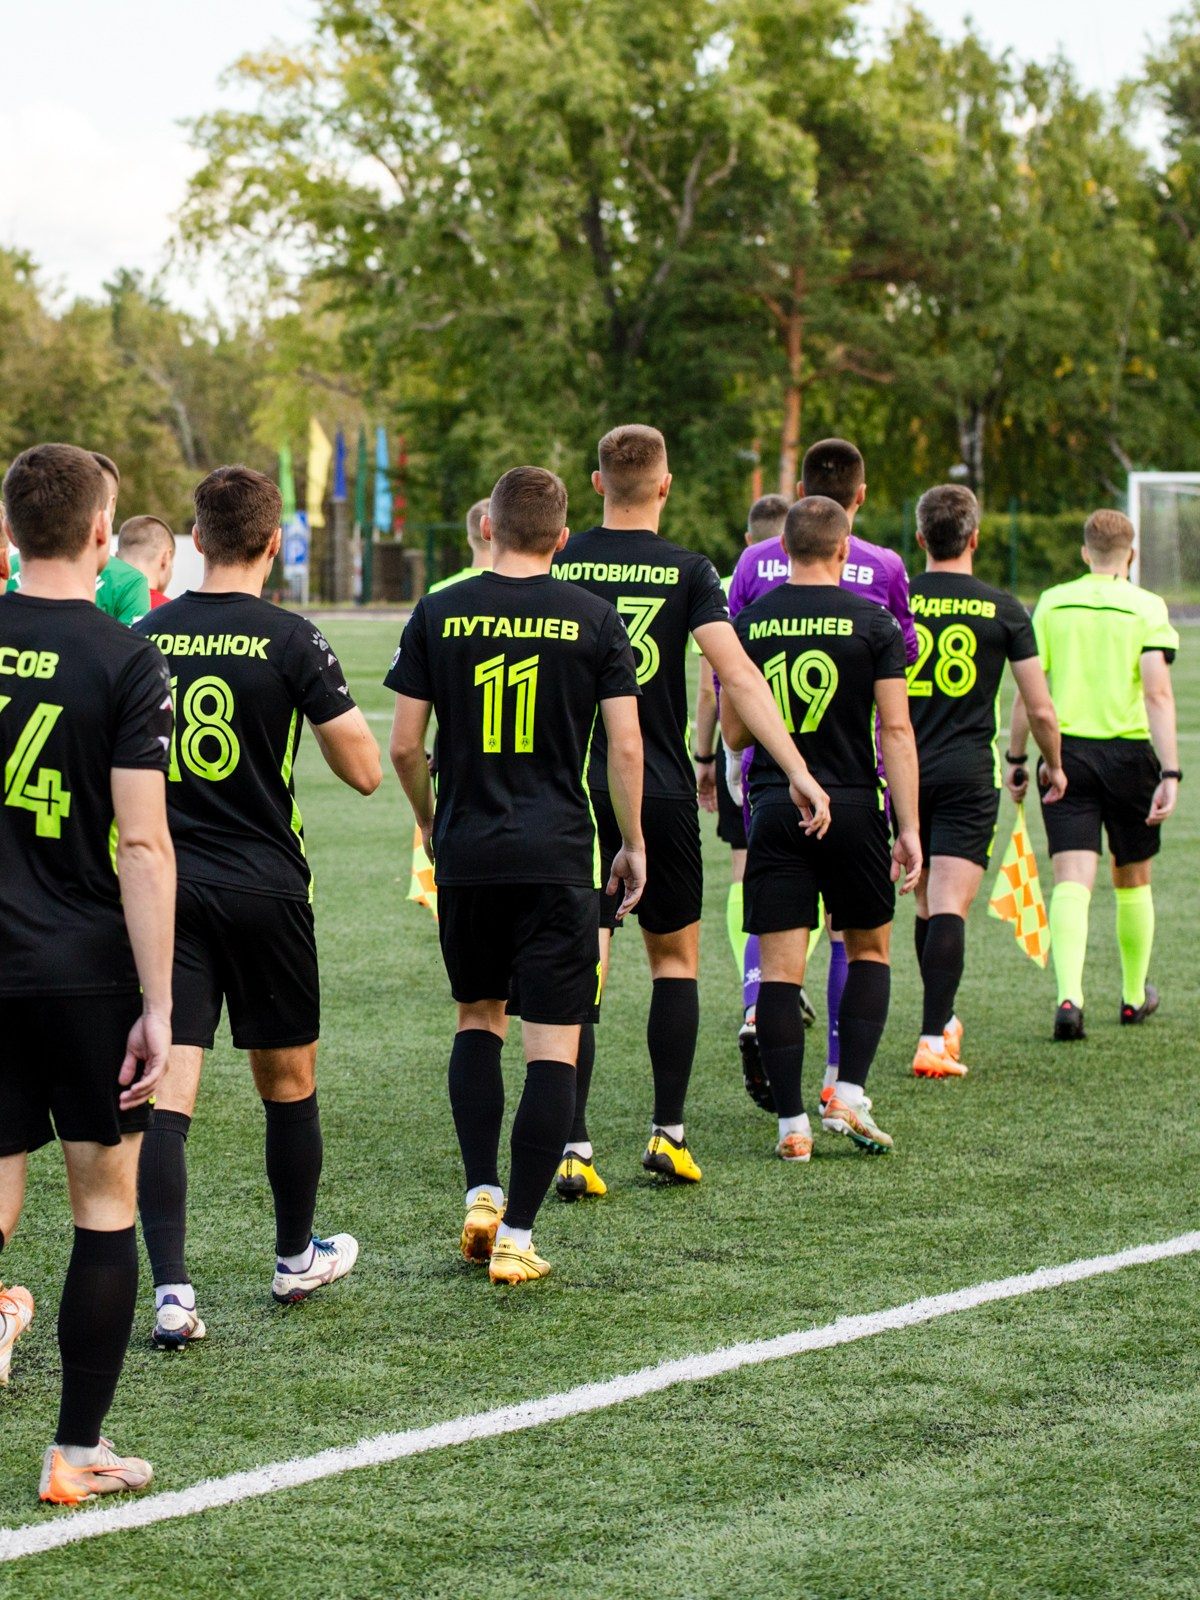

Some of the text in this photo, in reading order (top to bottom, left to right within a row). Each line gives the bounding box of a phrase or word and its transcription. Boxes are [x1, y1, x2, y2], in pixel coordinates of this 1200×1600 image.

[551, 562, 680, 585] МОТОВИЛОВ
[910, 595, 997, 619] ЙДЕНОВ
[442, 616, 580, 641] ЛУТАШЕВ
[616, 596, 667, 686] 3
[749, 617, 854, 640] МАШНЕВ
[146, 634, 271, 660] ОВАНЮК
[905, 622, 977, 697] 28
[474, 653, 540, 754] 11
[763, 649, 839, 734] 19
